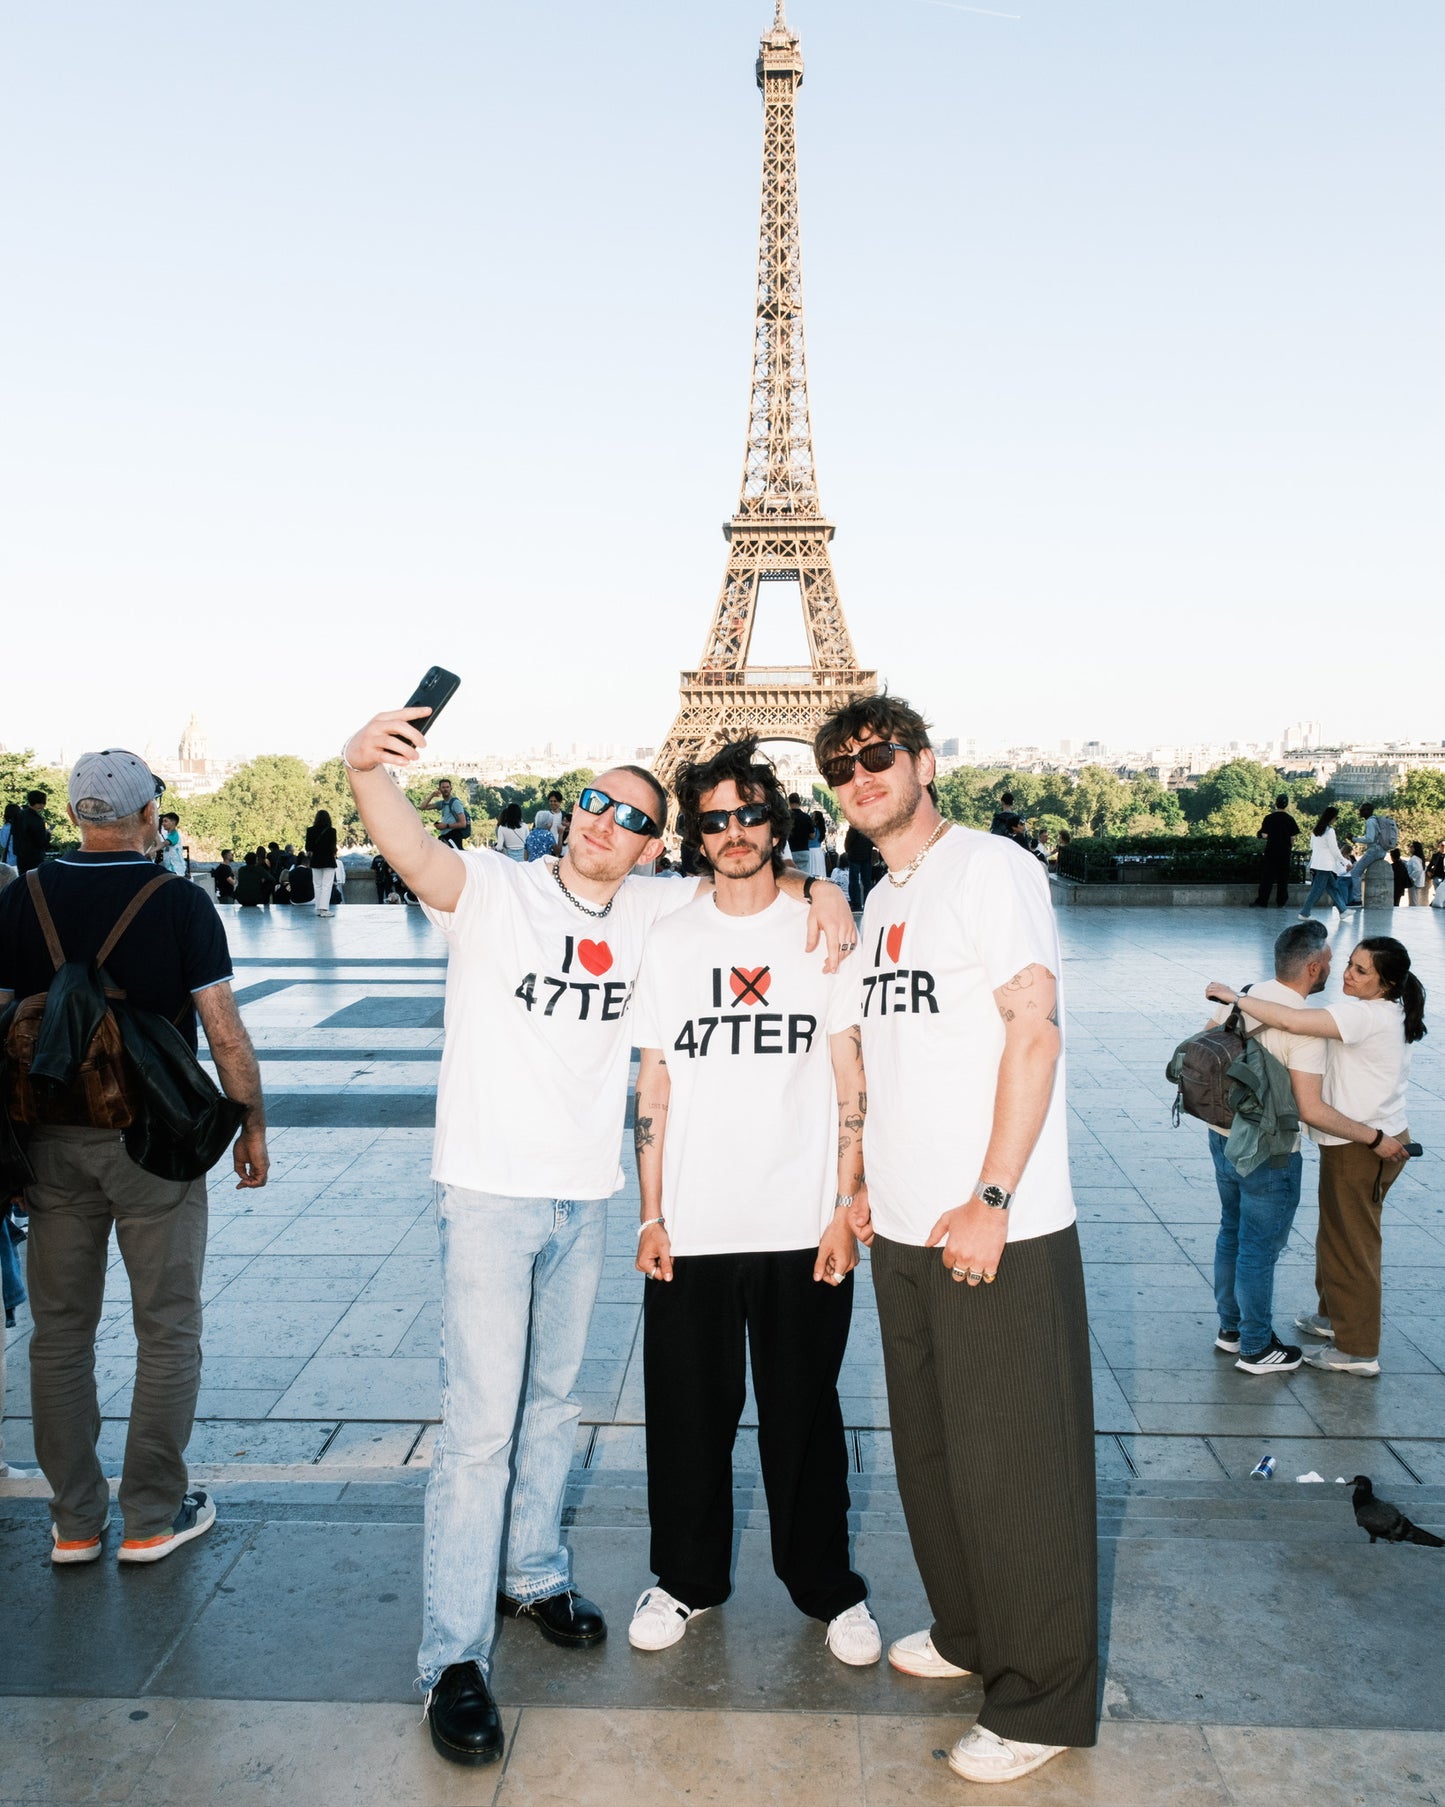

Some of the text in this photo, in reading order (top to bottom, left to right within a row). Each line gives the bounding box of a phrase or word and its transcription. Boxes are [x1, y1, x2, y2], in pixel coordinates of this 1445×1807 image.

[562, 935, 574, 974] I
[874, 926, 885, 968] I
[713, 968, 722, 1008] I
[860, 969, 940, 1018] 7TER
[674, 1013, 817, 1059] 47TER
